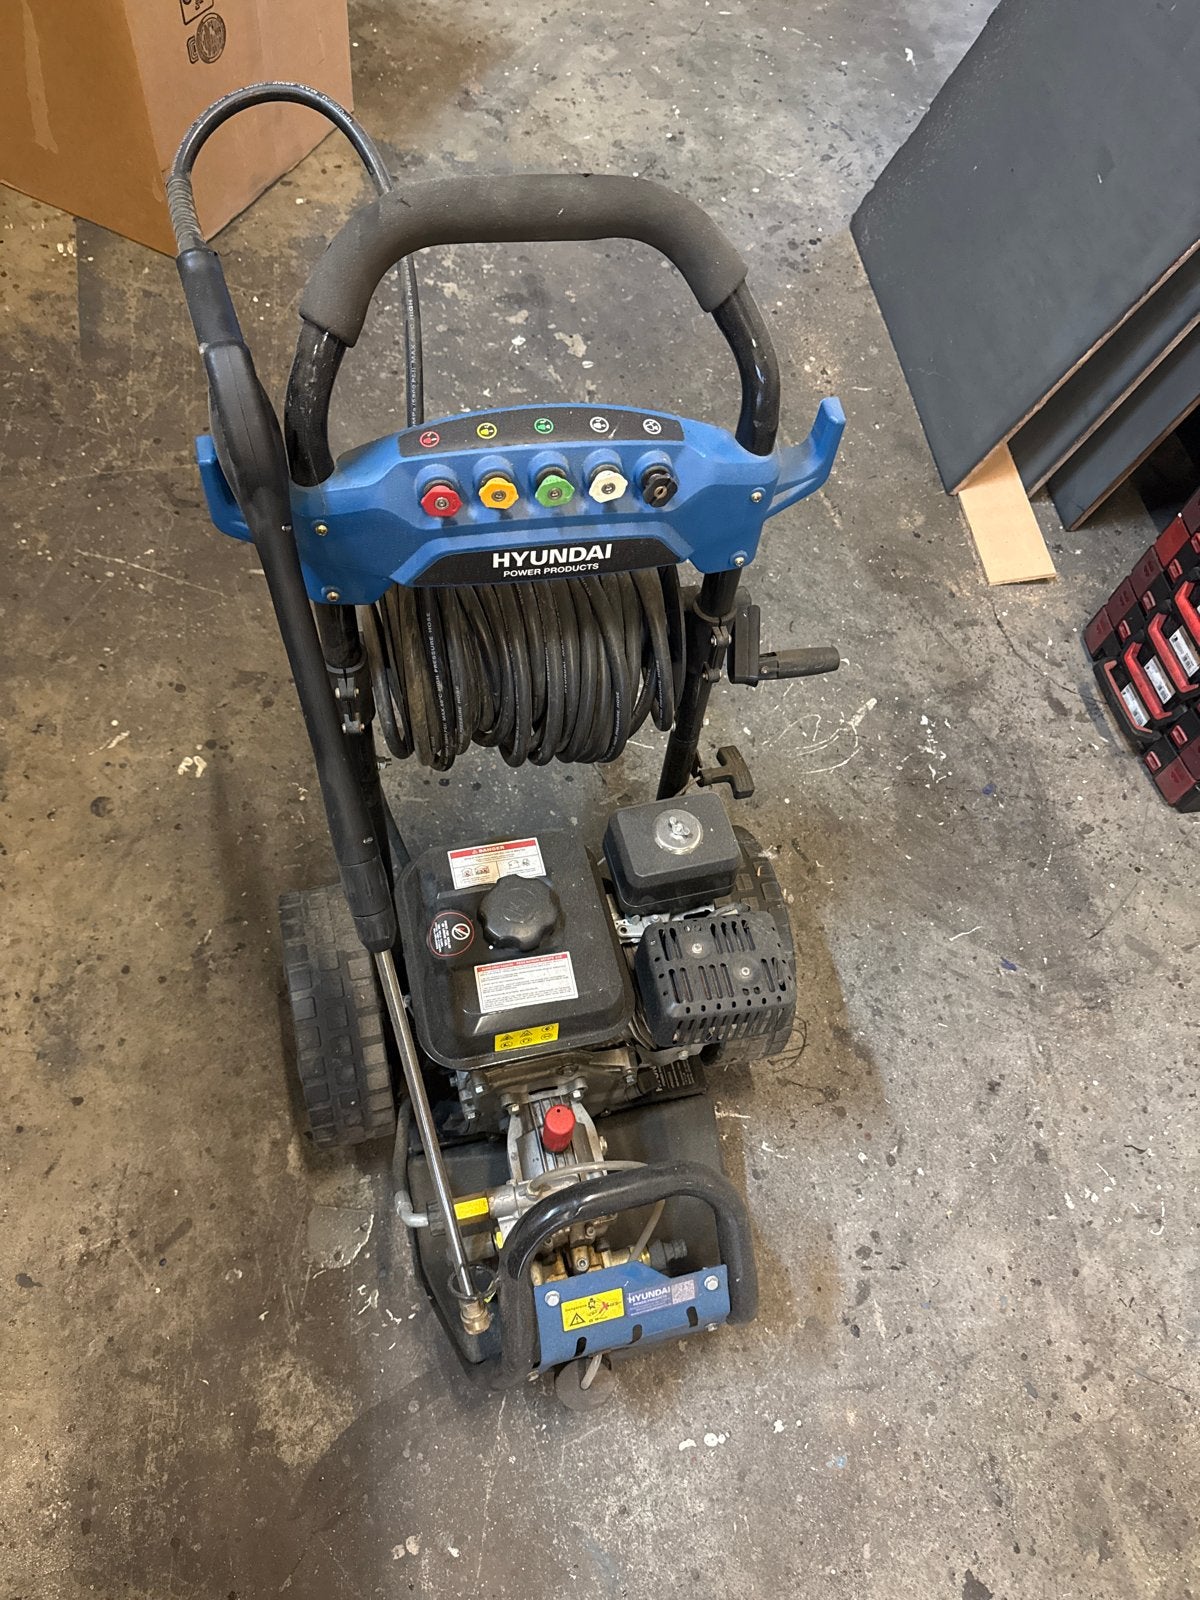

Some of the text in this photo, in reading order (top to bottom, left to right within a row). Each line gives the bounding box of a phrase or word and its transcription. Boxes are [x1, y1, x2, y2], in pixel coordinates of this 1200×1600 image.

[404, 256, 412, 297] PRESSUR
[492, 543, 612, 568] HYUNDAI
[503, 562, 599, 578] POWER PRODUCTS
[425, 611, 433, 633] HOSE
[428, 636, 439, 673] PRESSURE
[478, 845, 505, 854] DANGER
[628, 1286, 671, 1304] HYUNDAI
